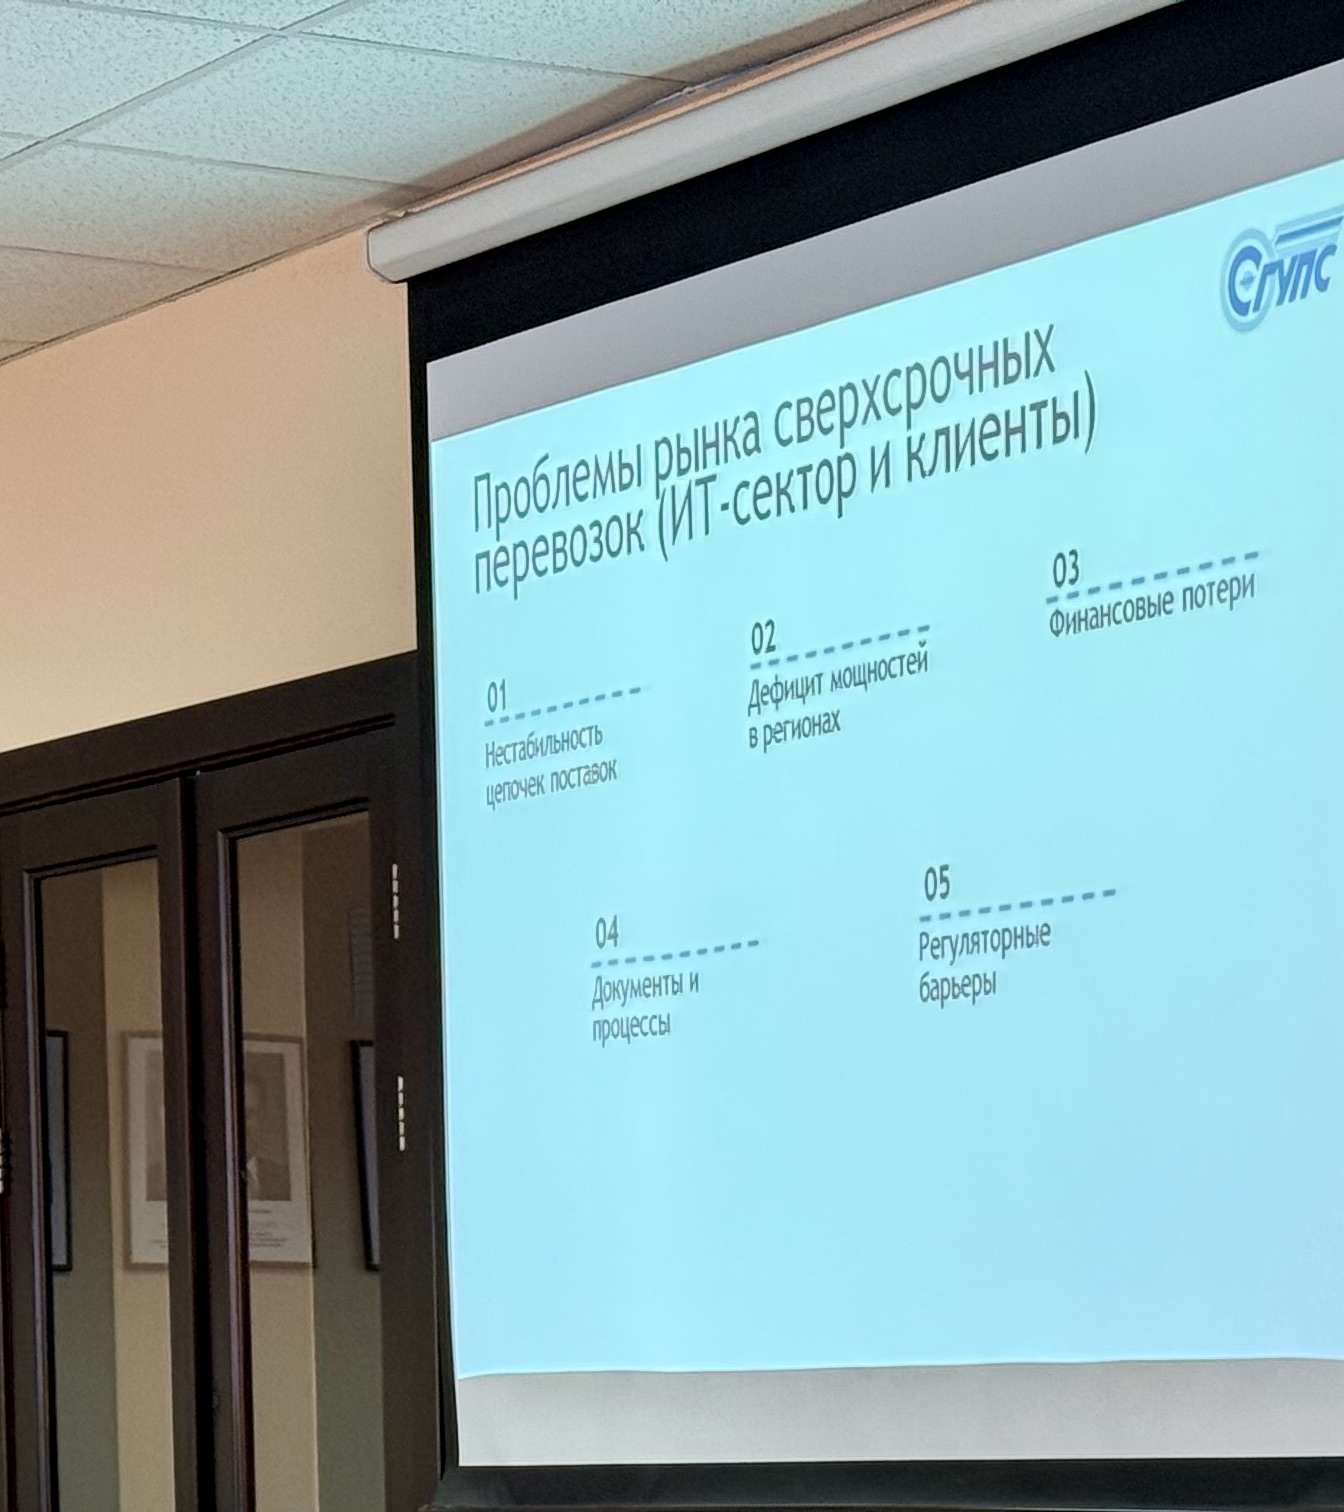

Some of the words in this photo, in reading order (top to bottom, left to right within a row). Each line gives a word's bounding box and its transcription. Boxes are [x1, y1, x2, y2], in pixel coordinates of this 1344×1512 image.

[1228, 243, 1338, 317] СГУПС
[474, 444, 641, 542] Проблемы
[655, 411, 761, 500] рынка
[775, 324, 1055, 449] сверхсрочных
[476, 509, 645, 600] перевозок
[658, 452, 856, 562] (ИТ-сектор
[871, 440, 890, 494] и
[907, 370, 1095, 482] клиенты)
[1053, 549, 1079, 588] 03
[1050, 591, 1174, 637] Финансовые
[1183, 573, 1254, 612] потери
[752, 619, 776, 655] 02
[488, 679, 506, 713] 01
[748, 673, 824, 717] Дефицит
[830, 640, 928, 692] мощностей
[486, 725, 603, 768] Нестабильность
[749, 727, 758, 749] в
[763, 709, 841, 753] регионах
[487, 775, 545, 811] цепочек
[551, 759, 617, 792] поставок
[924, 864, 950, 902] 05
[596, 915, 619, 949] 04
[919, 923, 1051, 966] Регуляторные
[592, 973, 683, 1010] Документы
[690, 972, 698, 993] и
[920, 971, 996, 1009] барьеры
[593, 1013, 670, 1048] процессы
